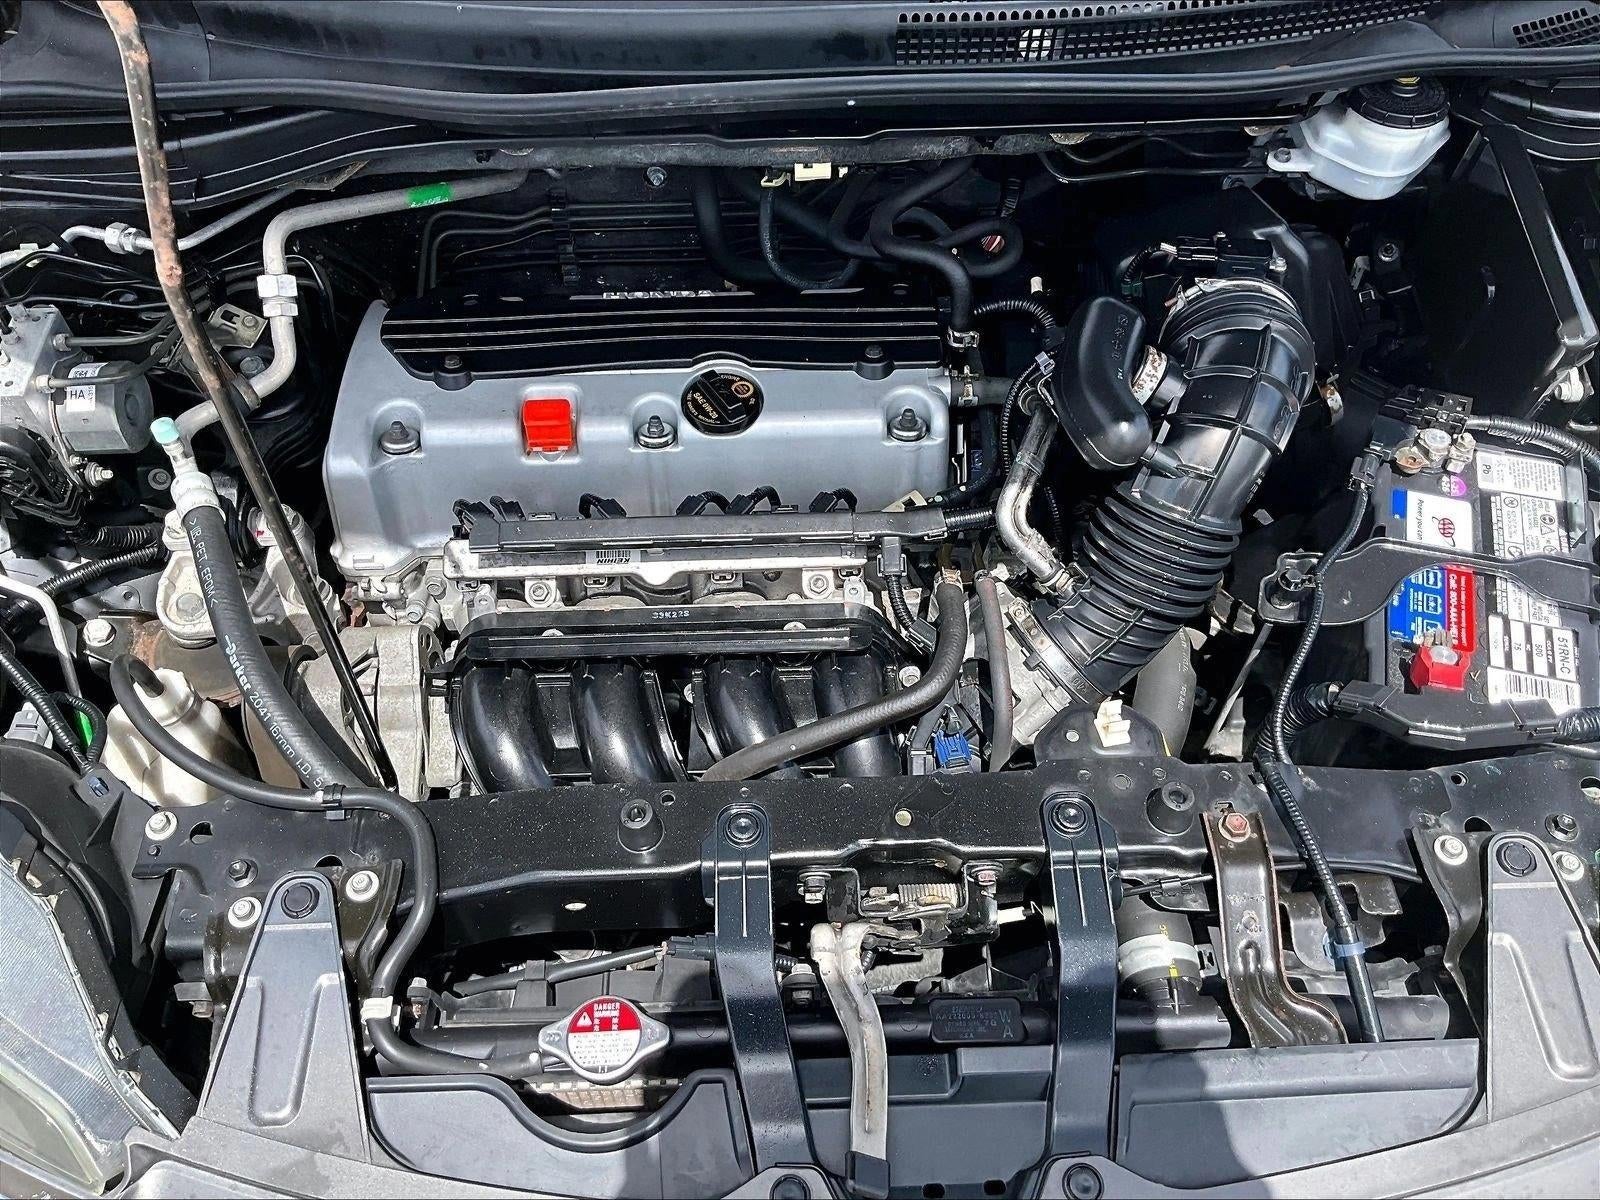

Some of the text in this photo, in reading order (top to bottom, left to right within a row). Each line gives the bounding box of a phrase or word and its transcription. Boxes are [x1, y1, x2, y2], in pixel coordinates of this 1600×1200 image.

[70, 389, 86, 400] HA
[1514, 642, 1522, 652] 75
[1535, 644, 1544, 657] 500
[1558, 637, 1571, 675] 51RN-C
[224, 634, 252, 691] Parker
[249, 690, 272, 722] 2041
[268, 721, 297, 759] 16mm
[594, 1002, 620, 1010] DANGER
